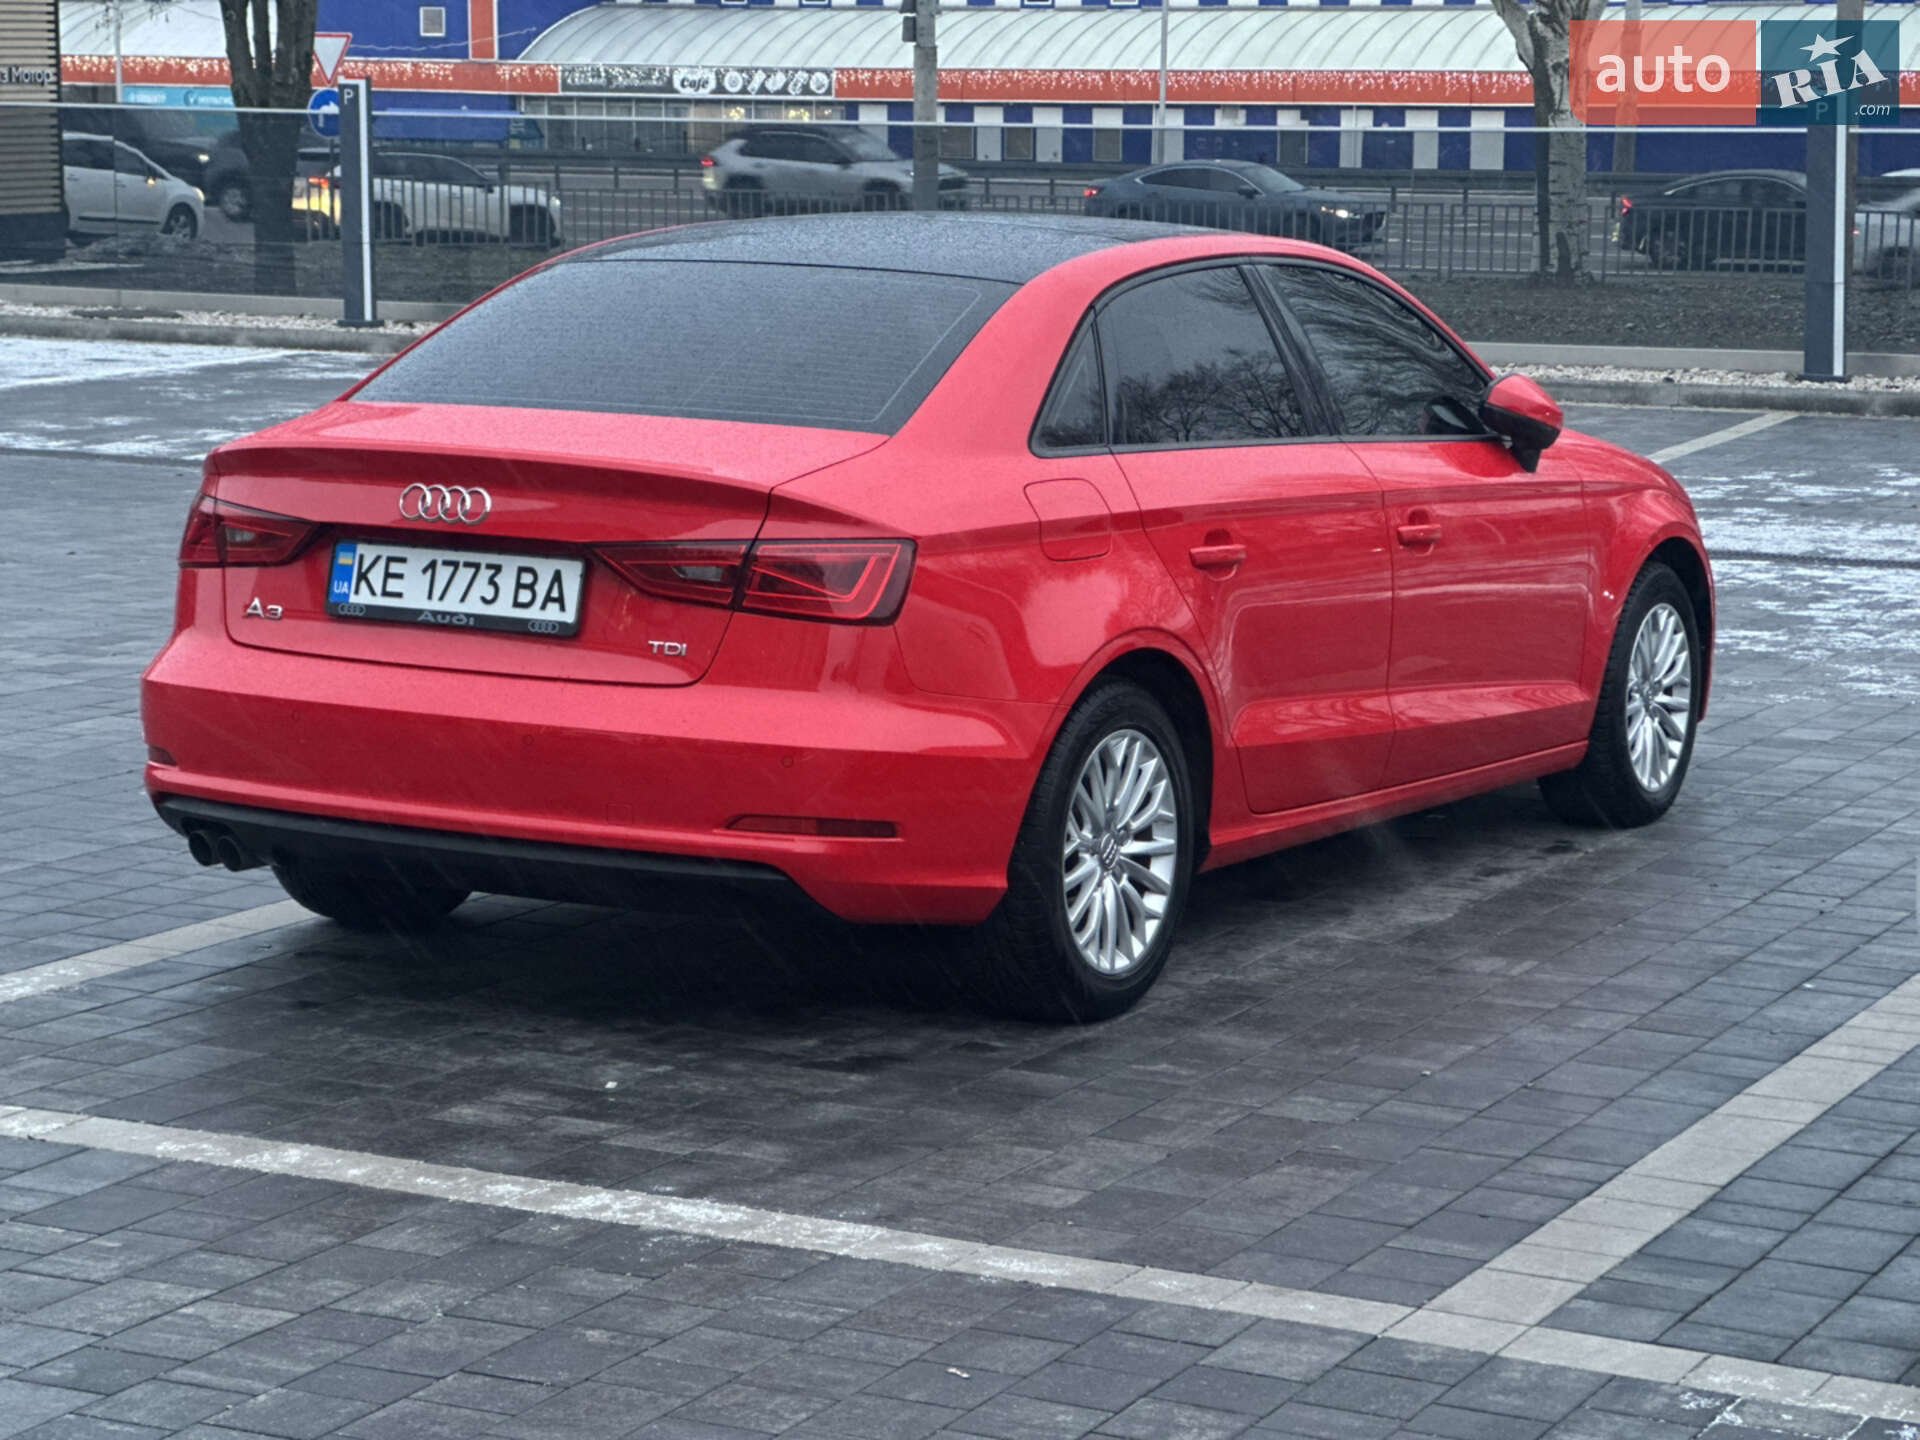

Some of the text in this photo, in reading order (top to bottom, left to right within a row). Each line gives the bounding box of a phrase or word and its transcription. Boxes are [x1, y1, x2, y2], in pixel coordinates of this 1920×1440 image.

[343, 88, 354, 105] P
[334, 580, 349, 594] UA
[353, 554, 567, 613] KE 1773 BA
[245, 597, 283, 620] A3
[417, 611, 475, 627] Audi
[648, 640, 687, 656] TDI
